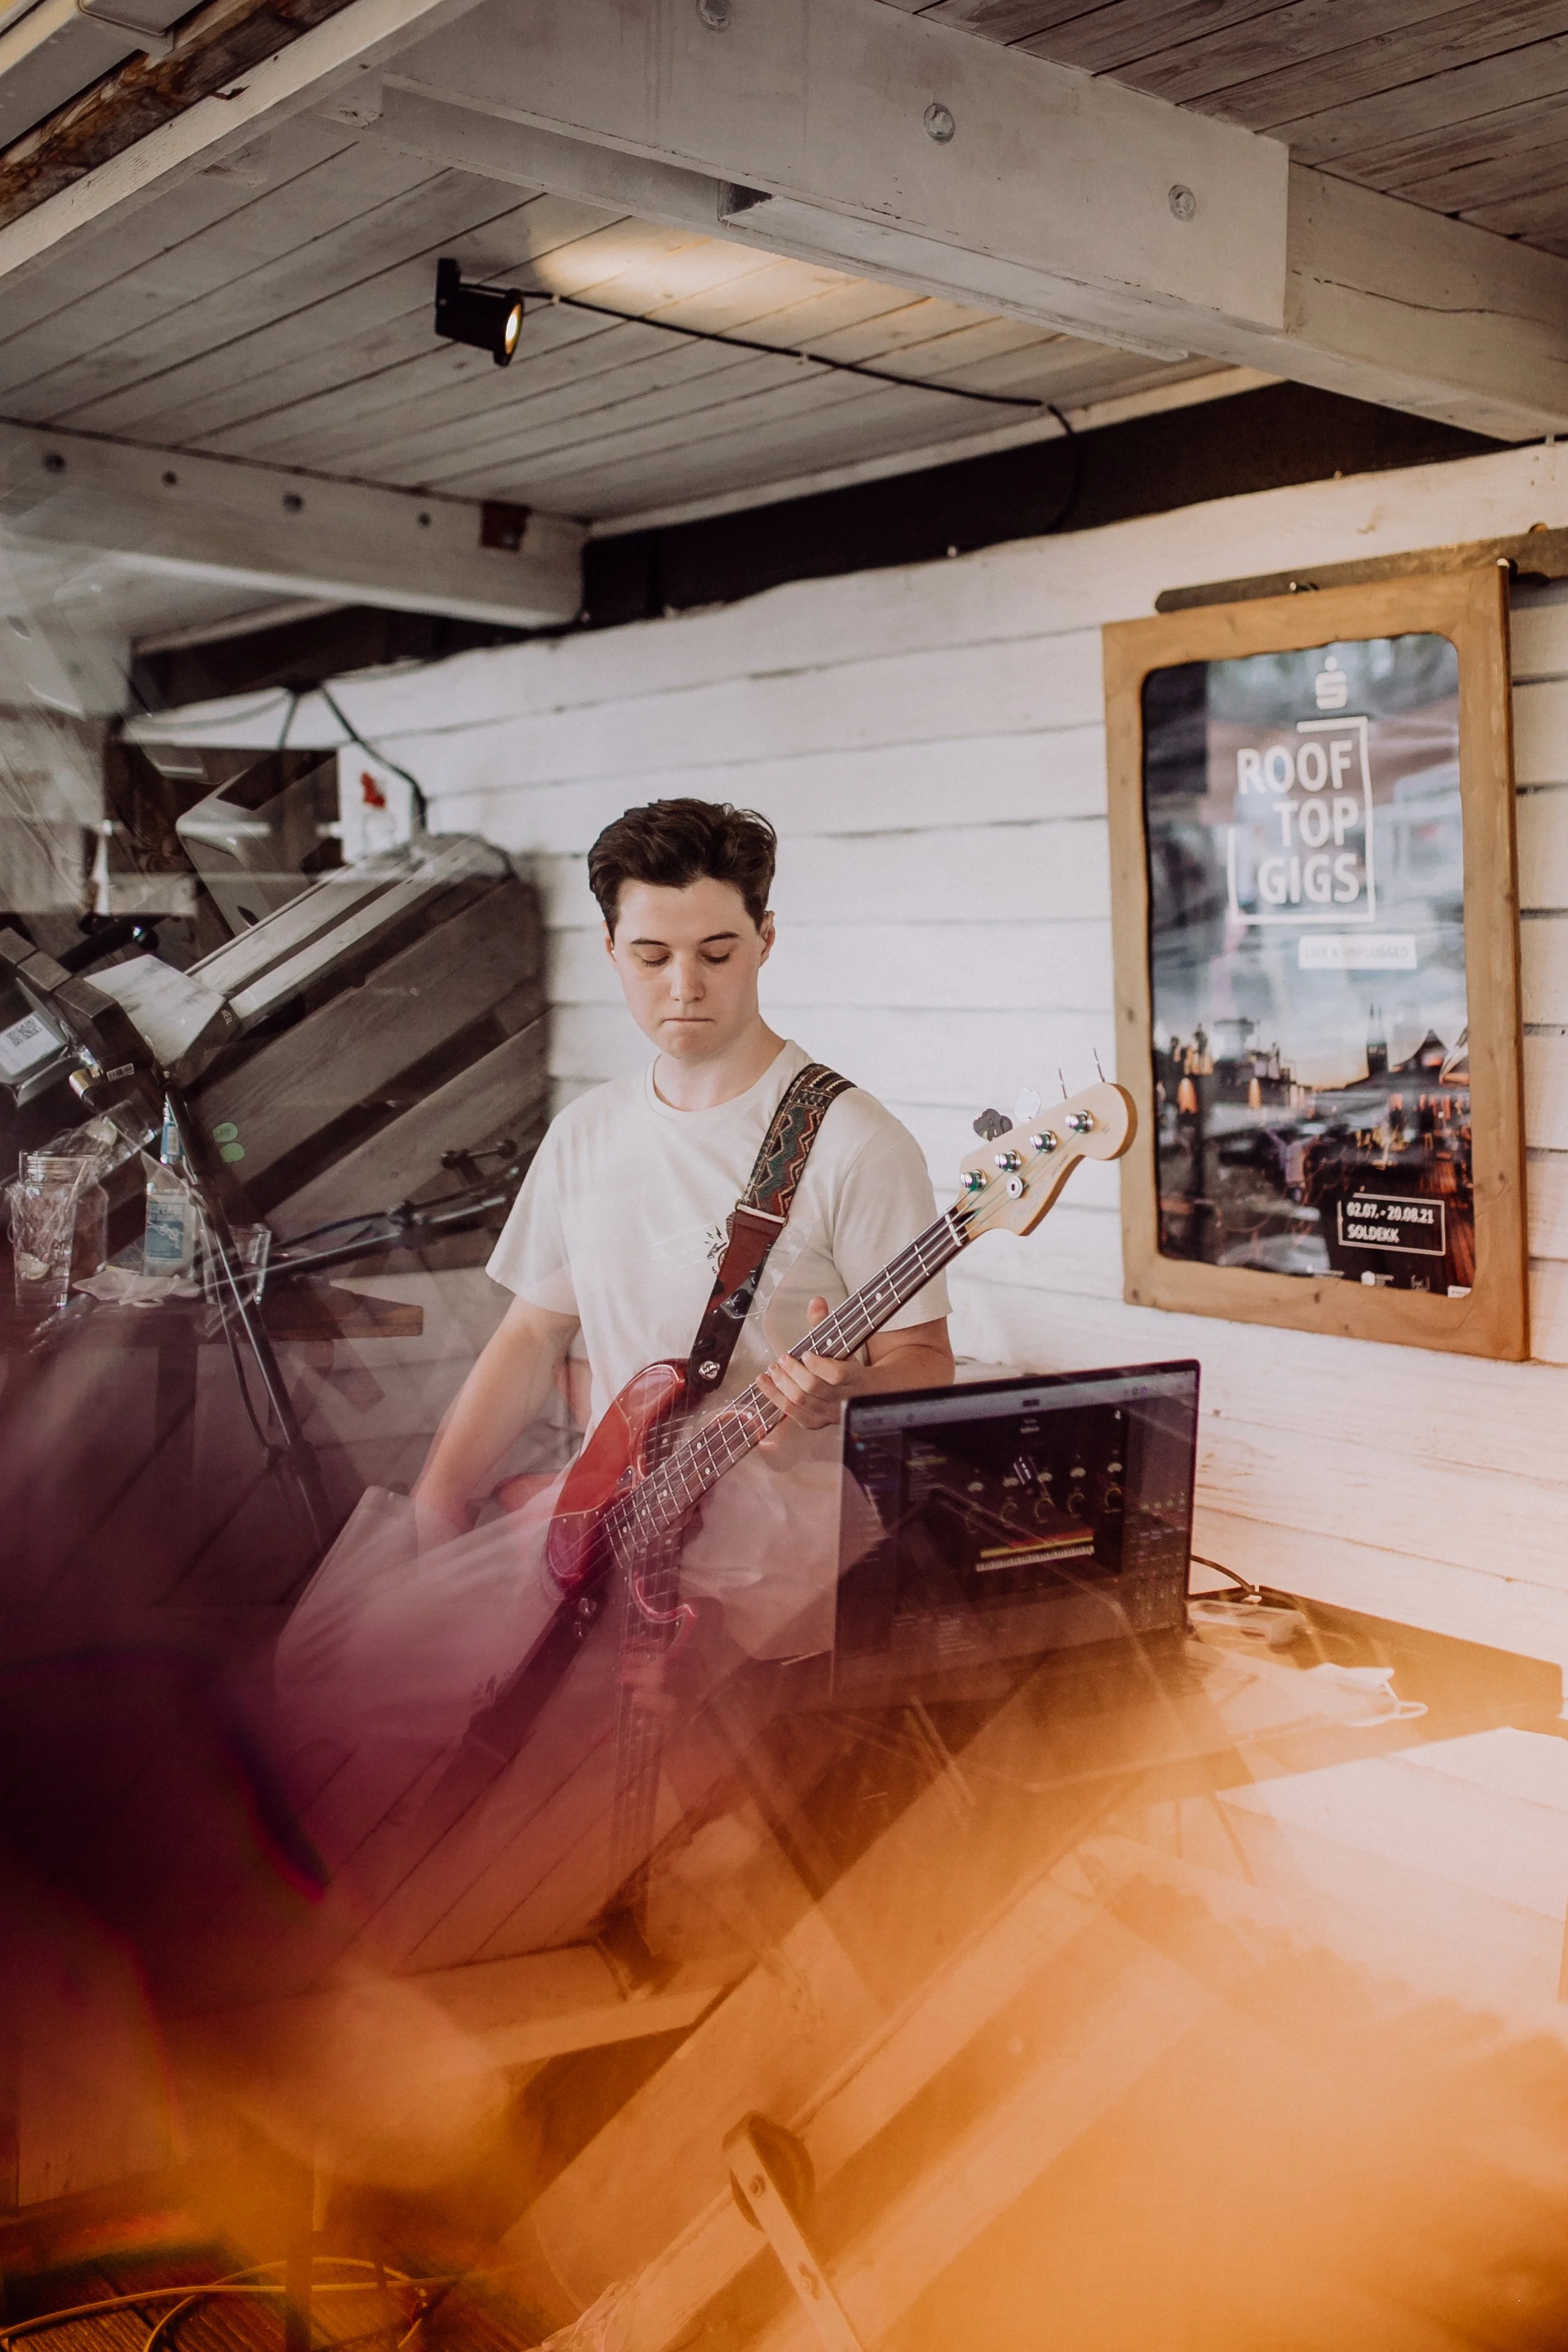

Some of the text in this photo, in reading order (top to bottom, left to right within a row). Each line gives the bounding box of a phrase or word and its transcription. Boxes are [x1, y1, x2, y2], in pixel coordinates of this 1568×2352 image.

[1237, 740, 1352, 794] ROOF
[1273, 797, 1360, 847] TOP
[1258, 852, 1360, 904] GIGS
[1347, 1224, 1400, 1243] SOLDEKK
[1387, 1205, 1434, 1224] 20.08.21
